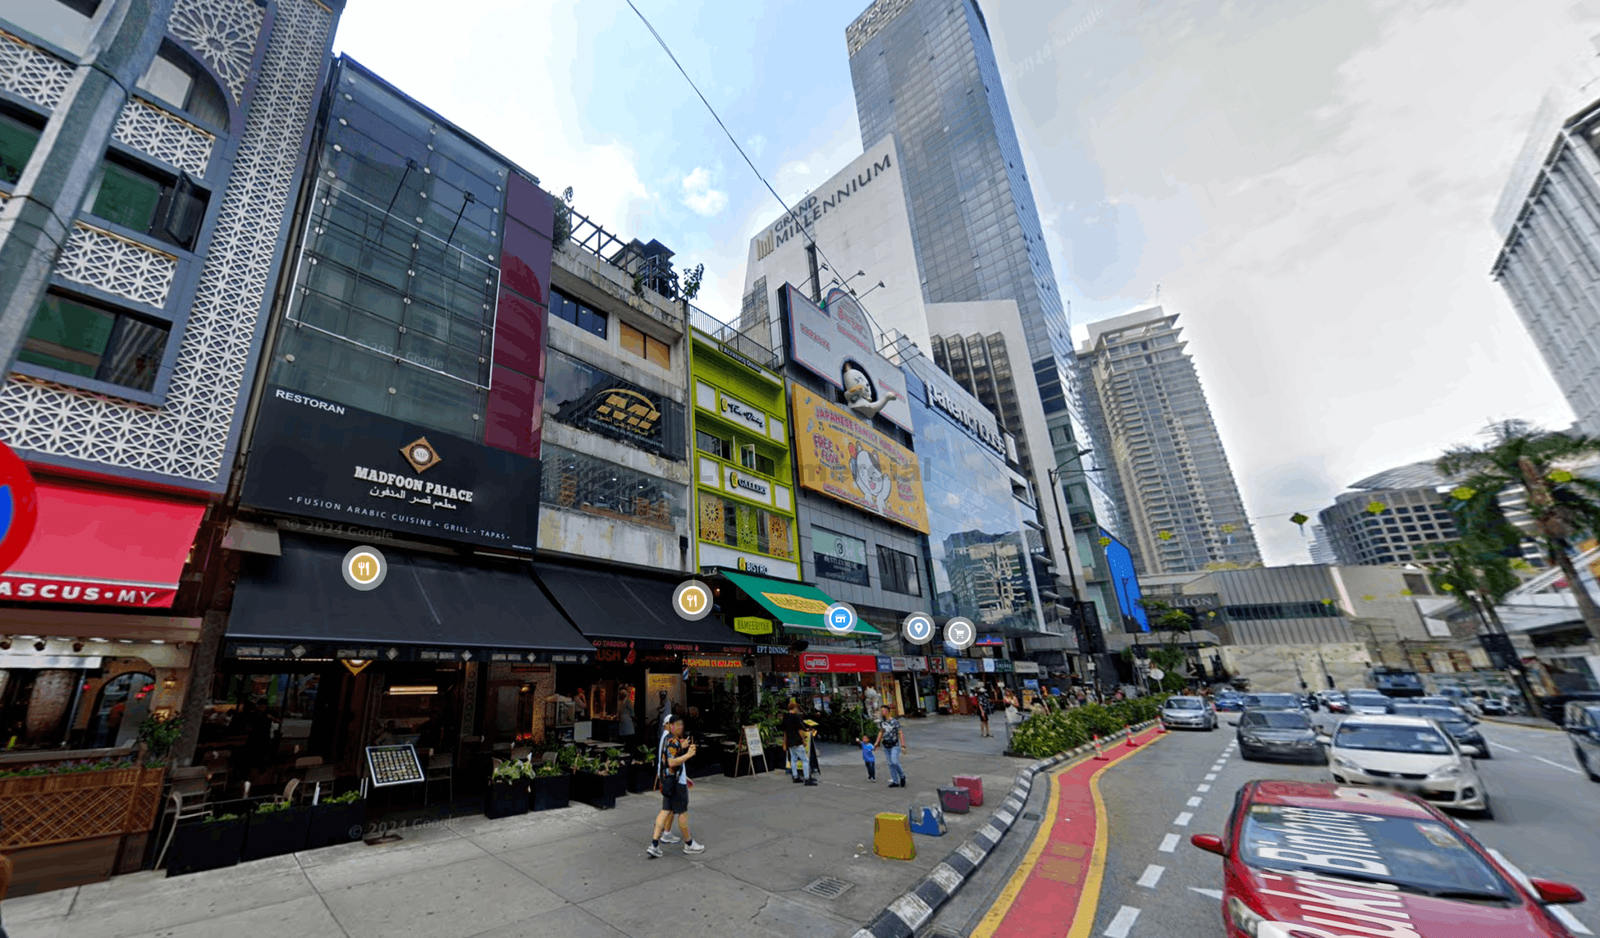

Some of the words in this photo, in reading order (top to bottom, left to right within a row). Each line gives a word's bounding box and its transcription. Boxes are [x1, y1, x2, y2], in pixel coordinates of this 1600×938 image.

[776, 153, 892, 247] MILLENNIUM
[774, 195, 818, 233] GRAND
[275, 389, 345, 415] RESTORAN
[815, 406, 854, 432] JAPANESE
[813, 432, 834, 454] FREE
[353, 465, 424, 492] MADFOON
[425, 482, 473, 503] PALACE
[736, 477, 768, 496] GALLERY
[408, 495, 432, 505] قصر
[432, 498, 457, 511] مطعم
[296, 496, 342, 511] FUSION
[346, 505, 387, 520] ARABIC
[391, 513, 433, 527] CUISINE
[443, 522, 470, 534] GRILL
[480, 529, 505, 541] TAPAS
[745, 561, 768, 575] BISTRO
[768, 646, 789, 655] DINING
